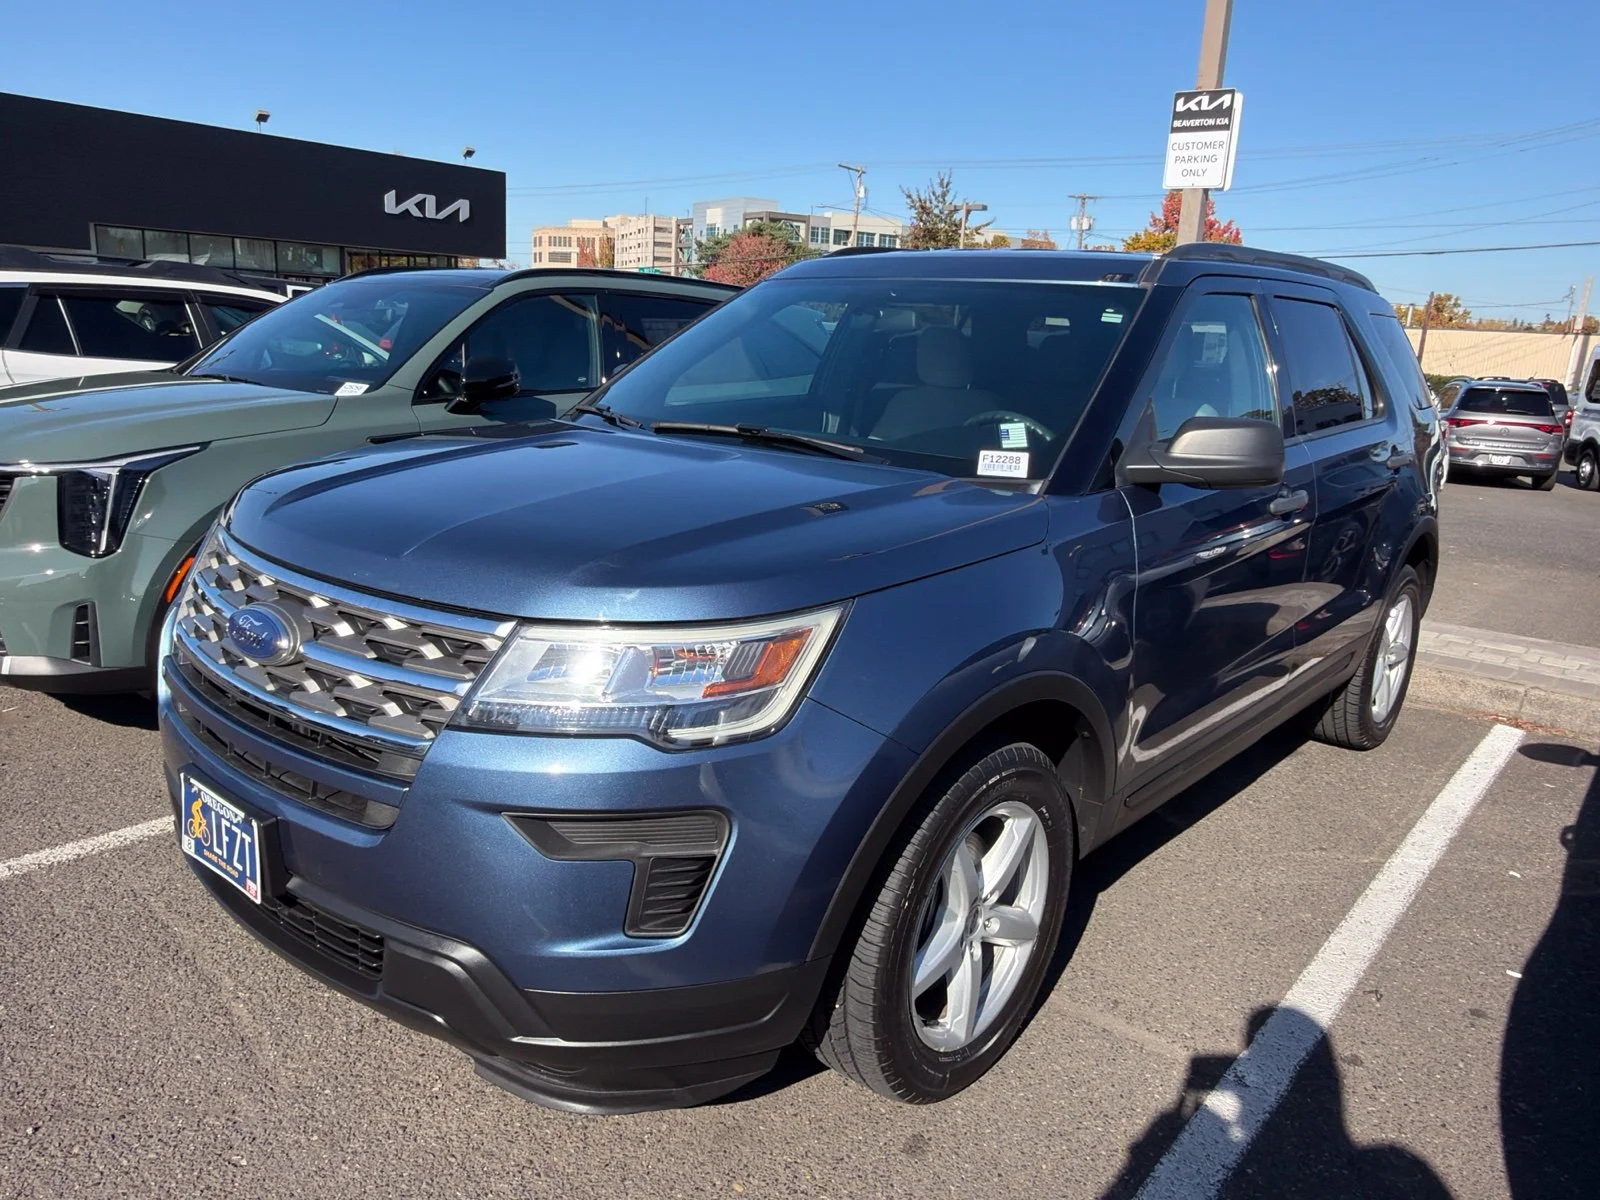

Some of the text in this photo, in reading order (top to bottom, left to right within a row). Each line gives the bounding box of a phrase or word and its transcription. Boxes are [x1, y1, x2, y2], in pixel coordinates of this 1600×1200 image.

[1173, 117, 1229, 128] BEAVERTON KIA
[1171, 140, 1225, 151] CUSTOMER
[1174, 154, 1218, 164] PARKING
[1181, 168, 1207, 178] ONLY
[384, 189, 470, 223] KIA
[982, 454, 1021, 465] F12288
[201, 791, 237, 822] OREGON
[211, 811, 252, 877] LFZT
